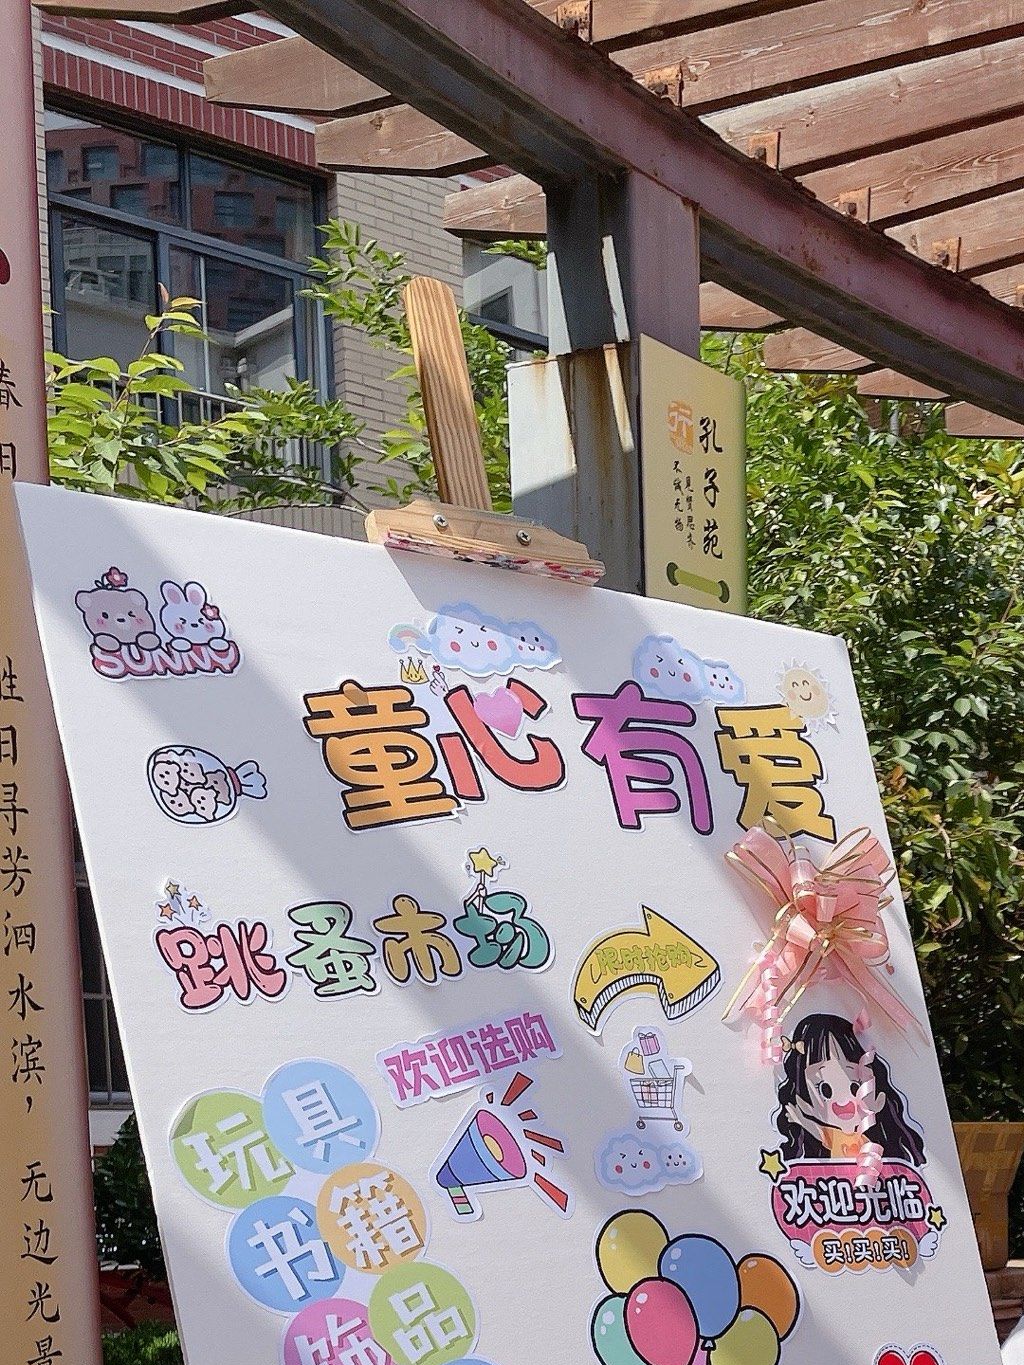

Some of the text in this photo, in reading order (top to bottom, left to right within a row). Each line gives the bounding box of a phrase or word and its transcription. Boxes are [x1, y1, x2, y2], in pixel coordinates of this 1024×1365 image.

[94, 642, 240, 677] SUNNY
[303, 678, 838, 843] 童心有爱
[154, 891, 552, 1011] 跳蚤市场
[595, 942, 692, 976] 限时抢购
[384, 1013, 555, 1101] 欢迎选购
[182, 1081, 365, 1197] 玩具
[248, 1172, 426, 1302] 书籍
[779, 1177, 925, 1227] 欢迎光临
